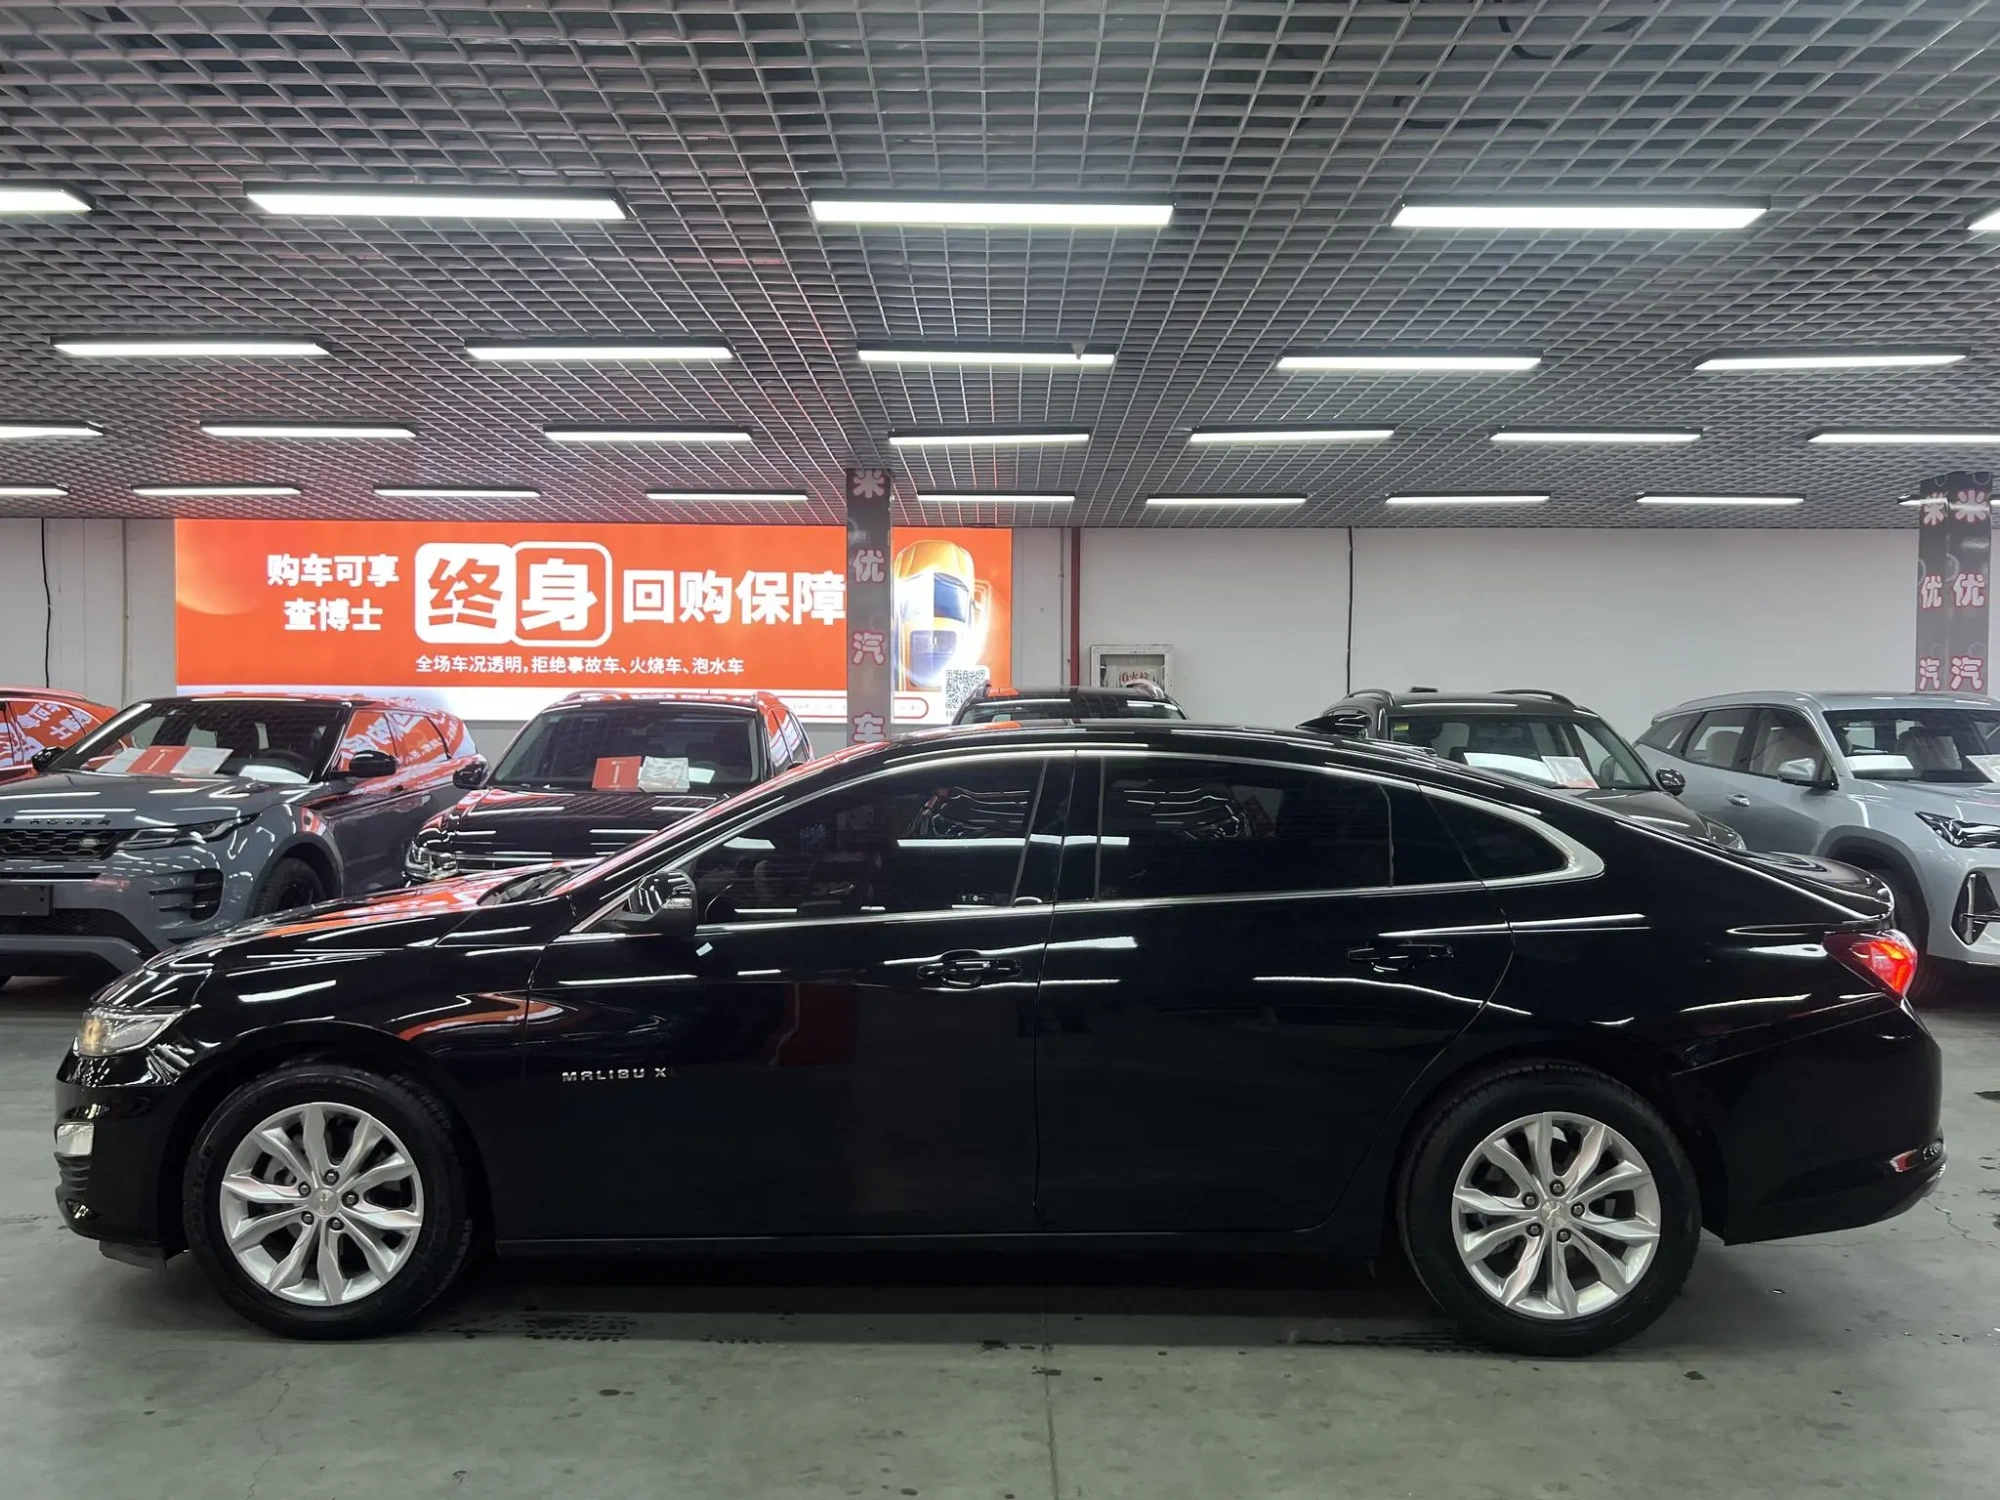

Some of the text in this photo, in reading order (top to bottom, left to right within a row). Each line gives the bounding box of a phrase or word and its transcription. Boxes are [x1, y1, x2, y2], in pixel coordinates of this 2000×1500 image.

[266, 553, 399, 588] 购车可享
[427, 557, 846, 632] 终身 回购保障
[283, 598, 384, 632] 查博士
[562, 1067, 667, 1081] MALIBU X
